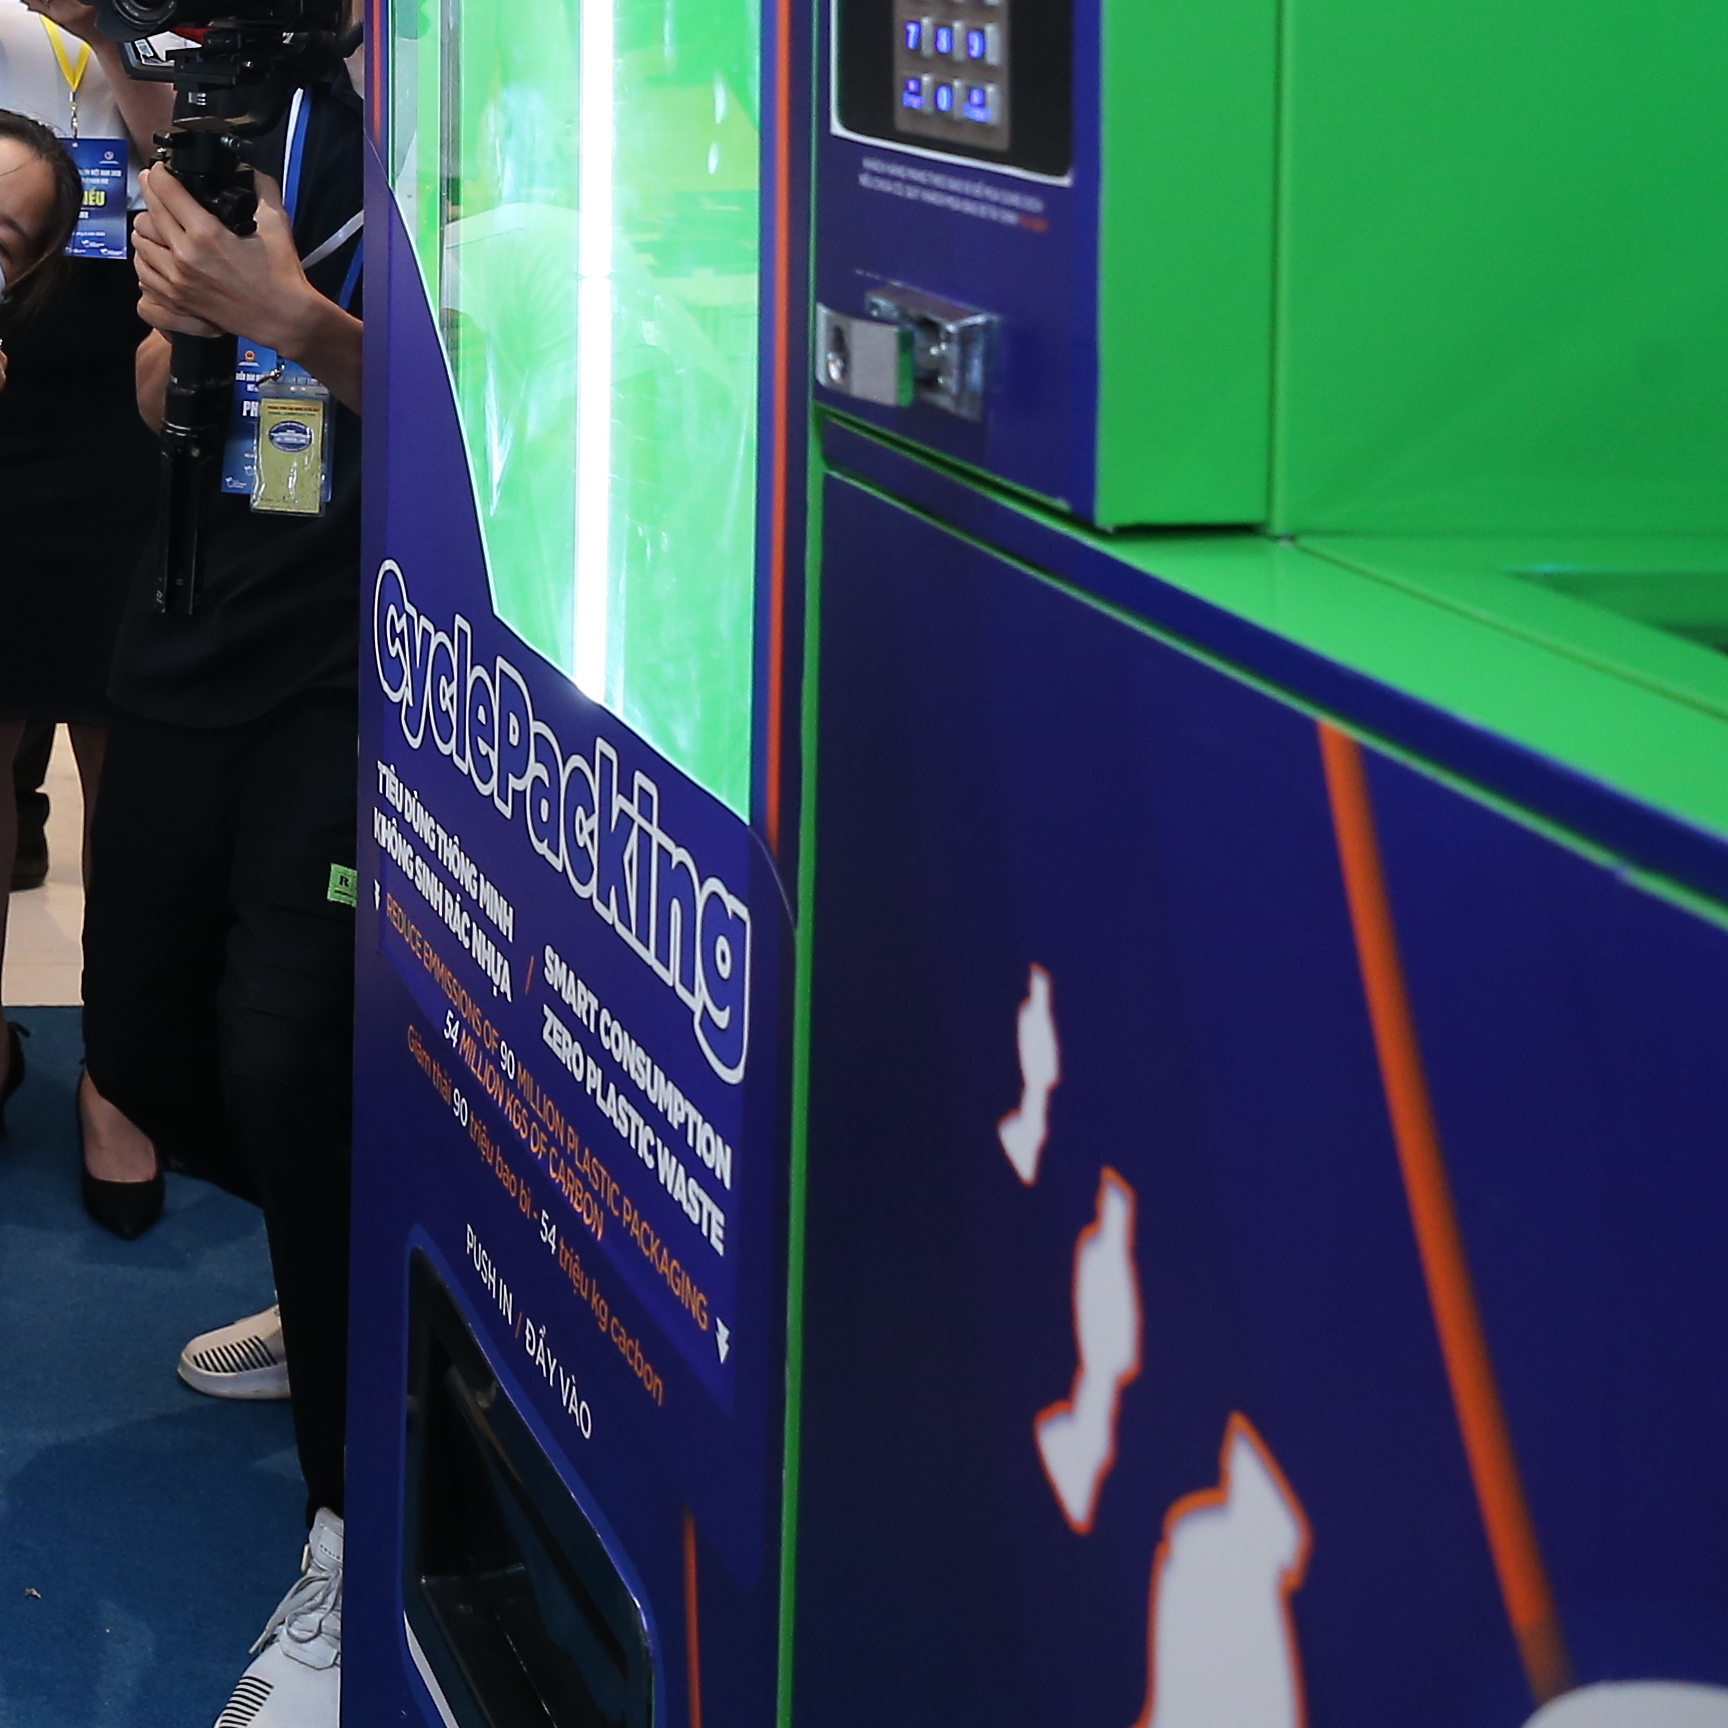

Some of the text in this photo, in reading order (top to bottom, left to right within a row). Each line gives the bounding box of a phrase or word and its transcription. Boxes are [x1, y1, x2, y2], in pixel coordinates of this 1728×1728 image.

[905, 21, 985, 59] 7 8 9
[935, 85, 952, 112] 0
[374, 807, 511, 1001] KHÔNG SINH RÁC NHỰA
[377, 760, 513, 941] TIÊU DÙNG THÔNG MINH
[386, 892, 421, 958] REDUCE
[483, 1019, 498, 1055] OF
[500, 1040, 515, 1079] 90
[517, 1061, 564, 1145] MILLION
[567, 1125, 619, 1215] PLASTIC
[622, 1197, 707, 1329] PACKAGING
[443, 1009, 602, 1240] 54 MILLION KGS OF CARBON
[542, 1004, 723, 1254] ZERO PLASTIC WASTE
[544, 945, 730, 1186] SMART CONSUMPTION
[453, 1087, 467, 1126] 90
[469, 1111, 493, 1165] triệu
[495, 1145, 516, 1197] bao
[539, 1209, 556, 1254] 54
[558, 1237, 588, 1299] triệu
[591, 1279, 608, 1332] kg
[610, 1317, 662, 1404] cacbon
[465, 1222, 496, 1299] PUSH
[498, 1277, 513, 1325] IN
[525, 1317, 558, 1387] ĐẨY
[558, 1366, 592, 1439] VÀO
